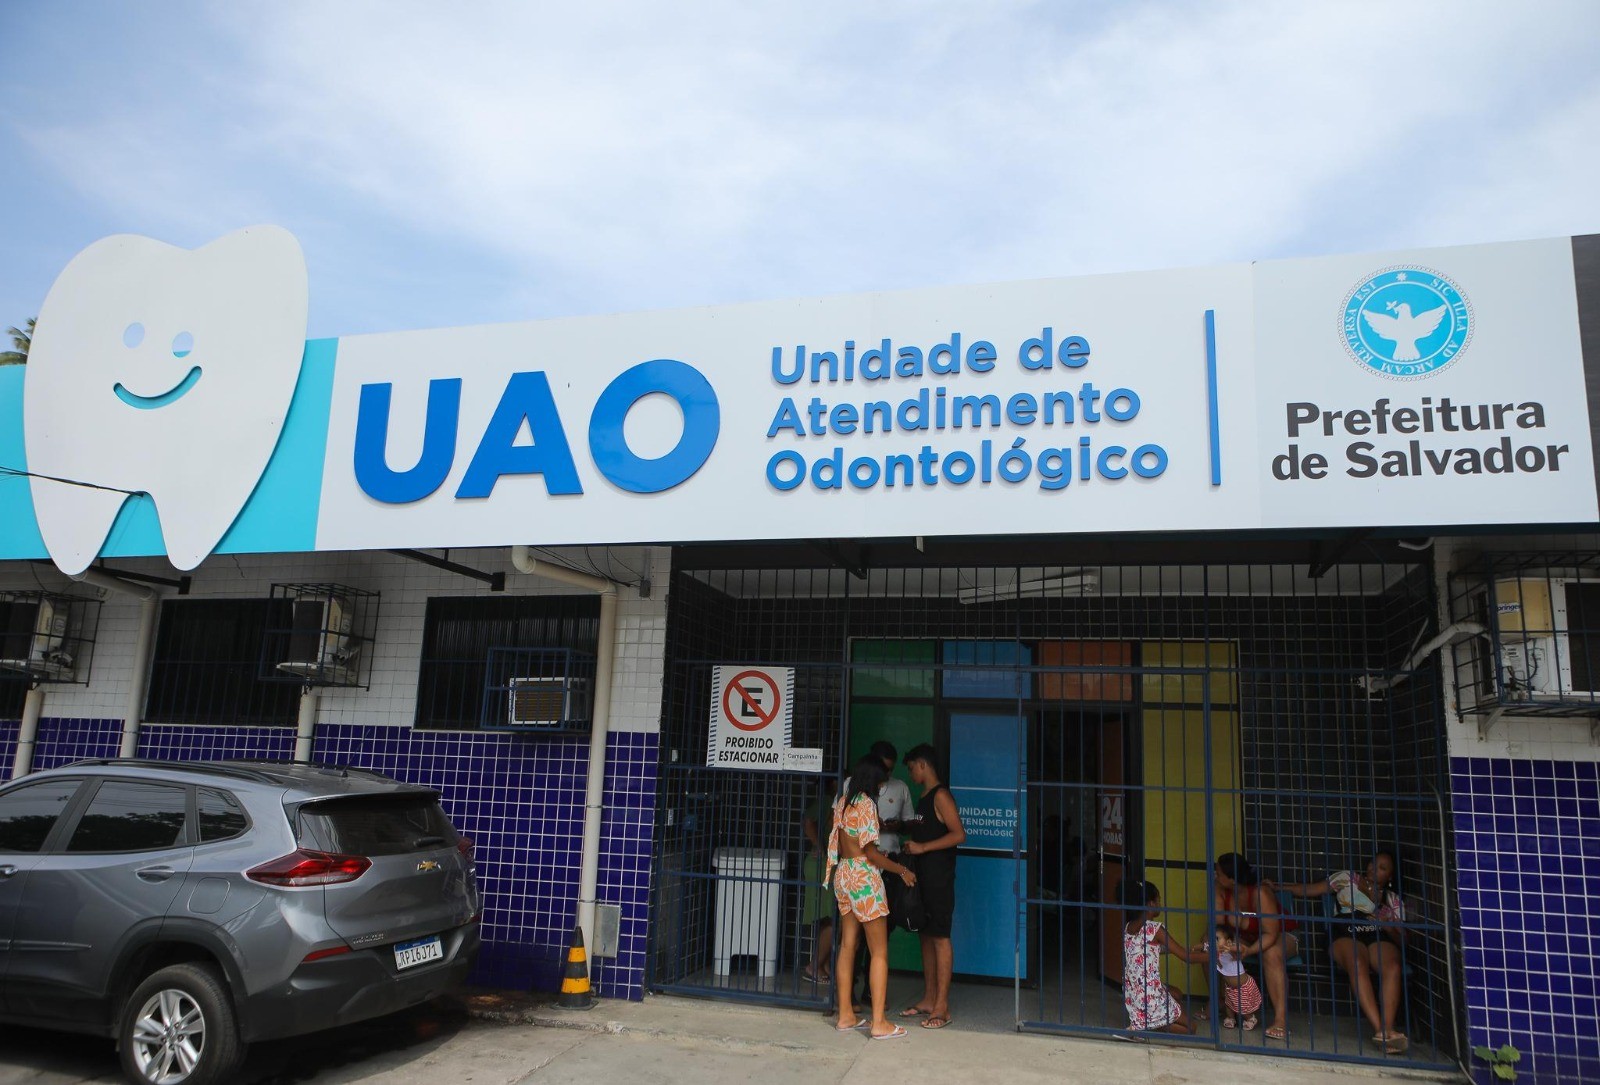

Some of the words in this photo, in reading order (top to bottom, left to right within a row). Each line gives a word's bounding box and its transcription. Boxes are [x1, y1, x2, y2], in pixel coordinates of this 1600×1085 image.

[1354, 281, 1379, 302] EST
[1430, 277, 1454, 297] SIC
[1452, 301, 1468, 332] ILLA
[1345, 309, 1372, 363] REVERSA
[1442, 339, 1459, 358] AD
[771, 332, 997, 385] Unidade
[1019, 326, 1091, 371] de
[1381, 360, 1435, 375] ARCAM
[766, 382, 1141, 438] Atendimento
[1285, 397, 1546, 438] Prefeitura
[353, 359, 721, 504] UAO
[765, 436, 1169, 491] Odontológico
[1271, 444, 1329, 481] de
[1345, 436, 1569, 479] Salvador
[724, 736, 774, 749] PROIBIDO
[718, 750, 779, 764] ESTACIONAR
[960, 817, 1017, 828] TENDIMENTO
[1103, 796, 1123, 831] 24
[964, 827, 1014, 837] ONTOLÓGIC
[400, 944, 438, 967] RPI6J71
